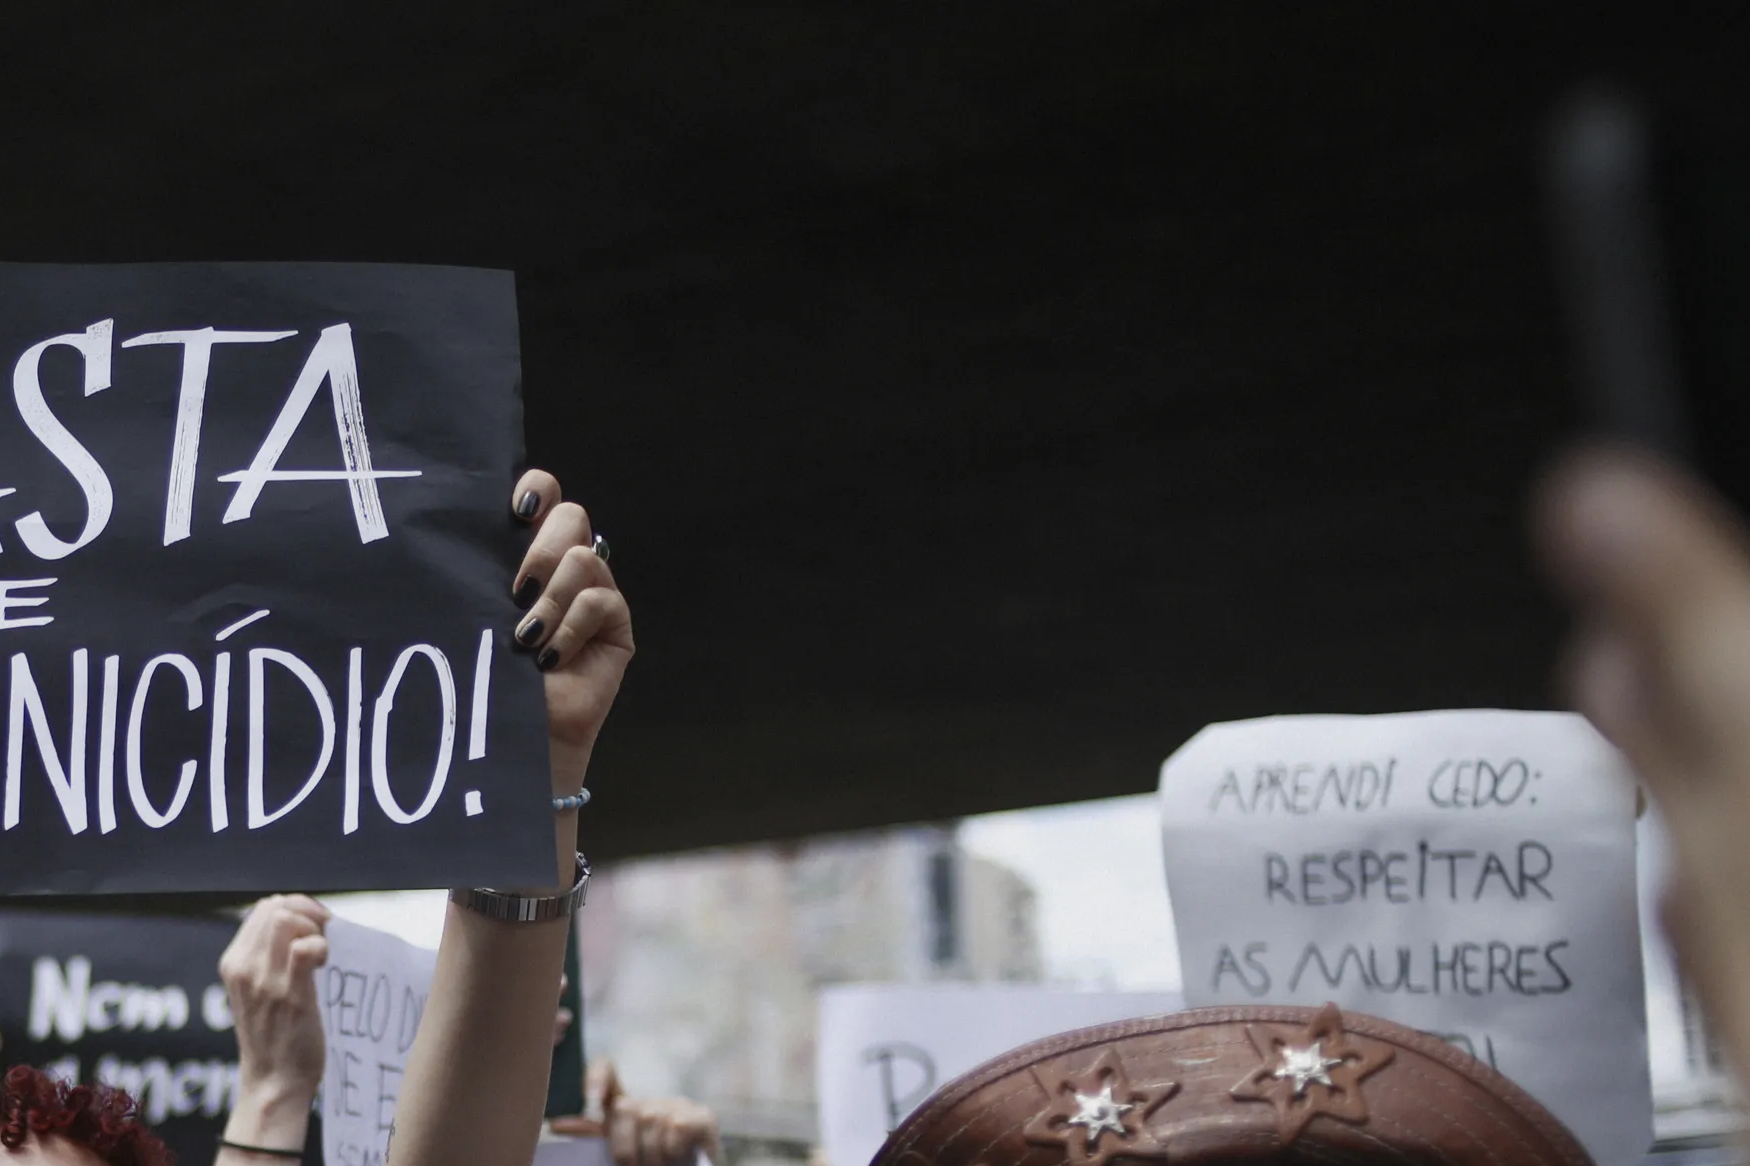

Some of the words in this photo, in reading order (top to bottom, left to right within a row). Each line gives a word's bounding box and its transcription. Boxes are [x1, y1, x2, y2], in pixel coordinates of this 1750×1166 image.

[1429, 758, 1543, 807] CEDO:
[1264, 840, 1554, 904] RESPEITAR
[29, 955, 189, 1042] Nem
[1210, 941, 1272, 998] AS
[1288, 940, 1572, 996] MULHERES
[325, 965, 392, 1043] PELO
